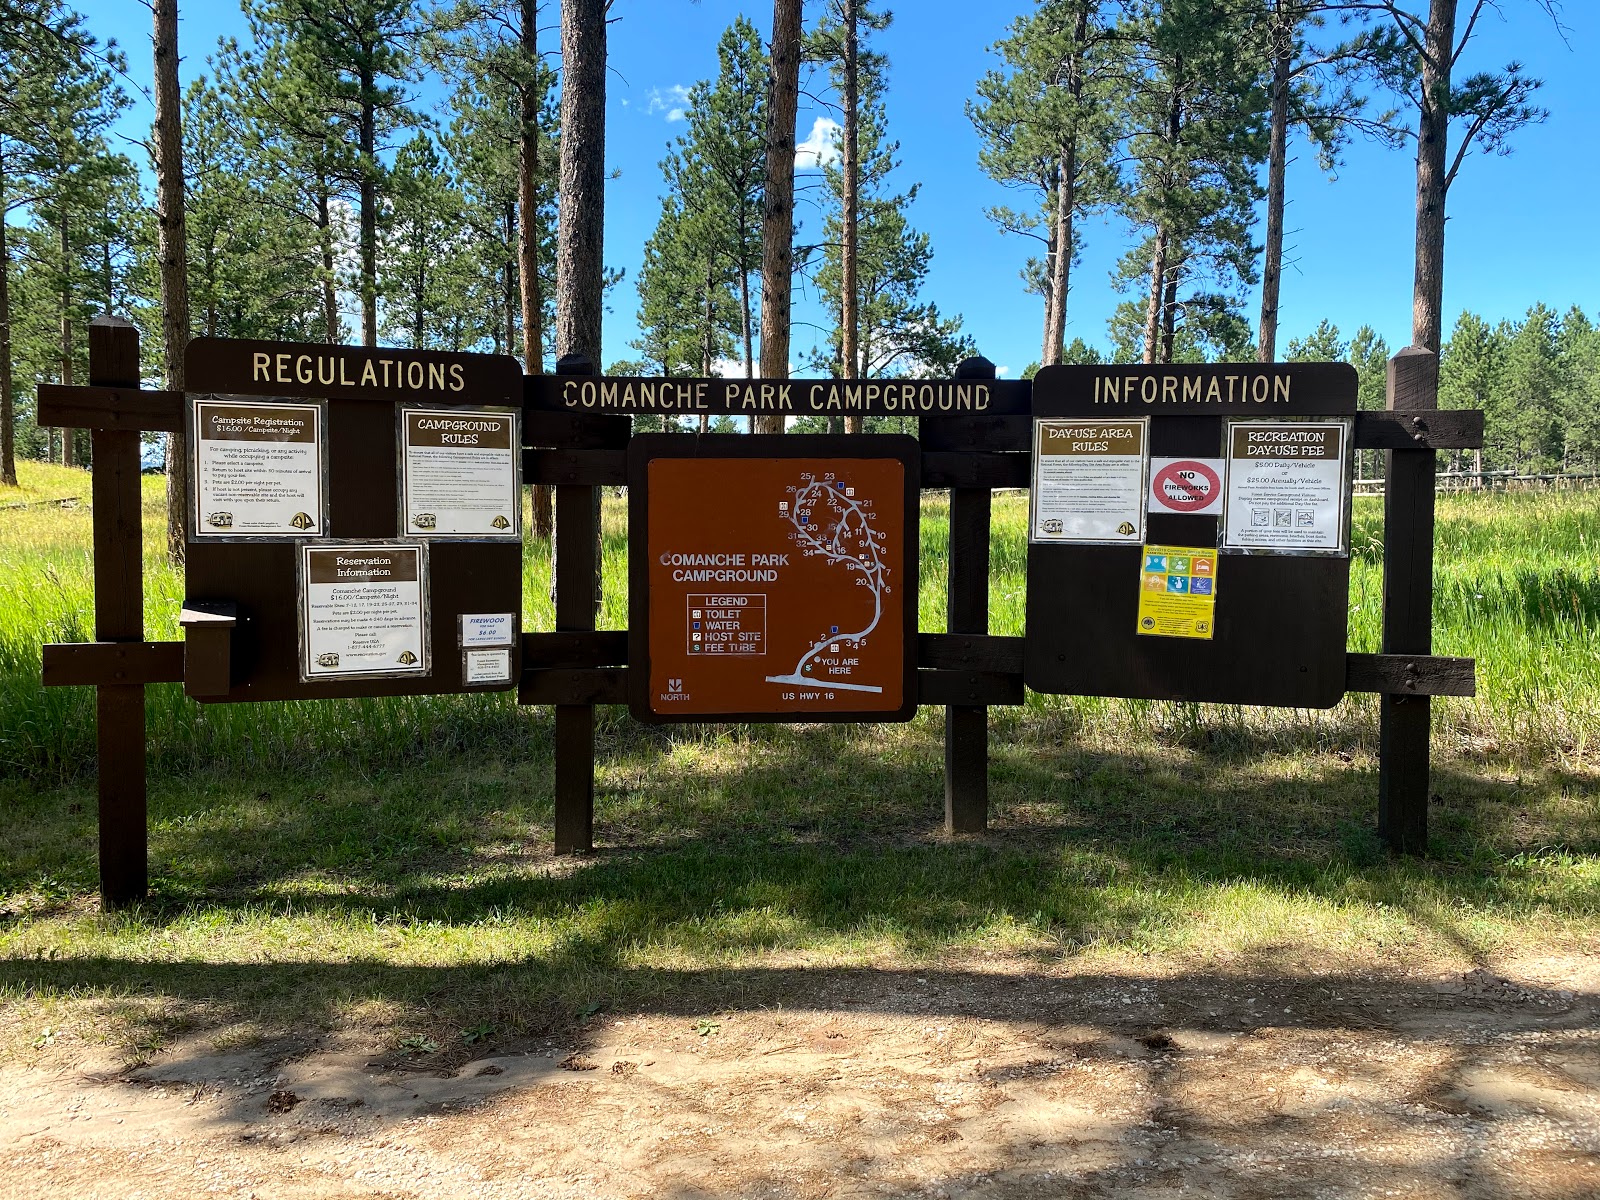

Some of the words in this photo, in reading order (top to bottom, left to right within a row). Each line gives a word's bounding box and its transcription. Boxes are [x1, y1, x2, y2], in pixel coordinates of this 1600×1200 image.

[252, 352, 466, 392] REGULATIONS
[563, 380, 708, 409] COMANCHE
[726, 383, 793, 409] PARK
[810, 384, 990, 410] CAMPGROUND
[1094, 375, 1292, 404] INFORMATION
[212, 416, 252, 425] Campsite
[254, 417, 304, 427] Registration
[418, 419, 500, 432] CAMPGROUND
[441, 433, 478, 444] RULES
[1049, 428, 1097, 438] DAY-USE
[1100, 428, 1133, 438] AREA
[1248, 431, 1325, 442] RECREATION
[1072, 441, 1108, 452] RULES
[1247, 445, 1298, 455] DAY-USE
[1302, 446, 1324, 456] FEE
[336, 557, 391, 565] Reservation
[660, 554, 745, 566] COMANCHE
[752, 554, 789, 566] PARK
[337, 568, 391, 577] Information
[673, 570, 778, 582] CAMPGROUND
[706, 597, 748, 606] LEGEND
[705, 610, 741, 619] TOILET
[705, 621, 740, 630] WATER
[705, 632, 734, 641] HOST
[738, 632, 761, 641] SITE
[705, 644, 724, 652] FEE
[728, 643, 756, 652] TUBE
